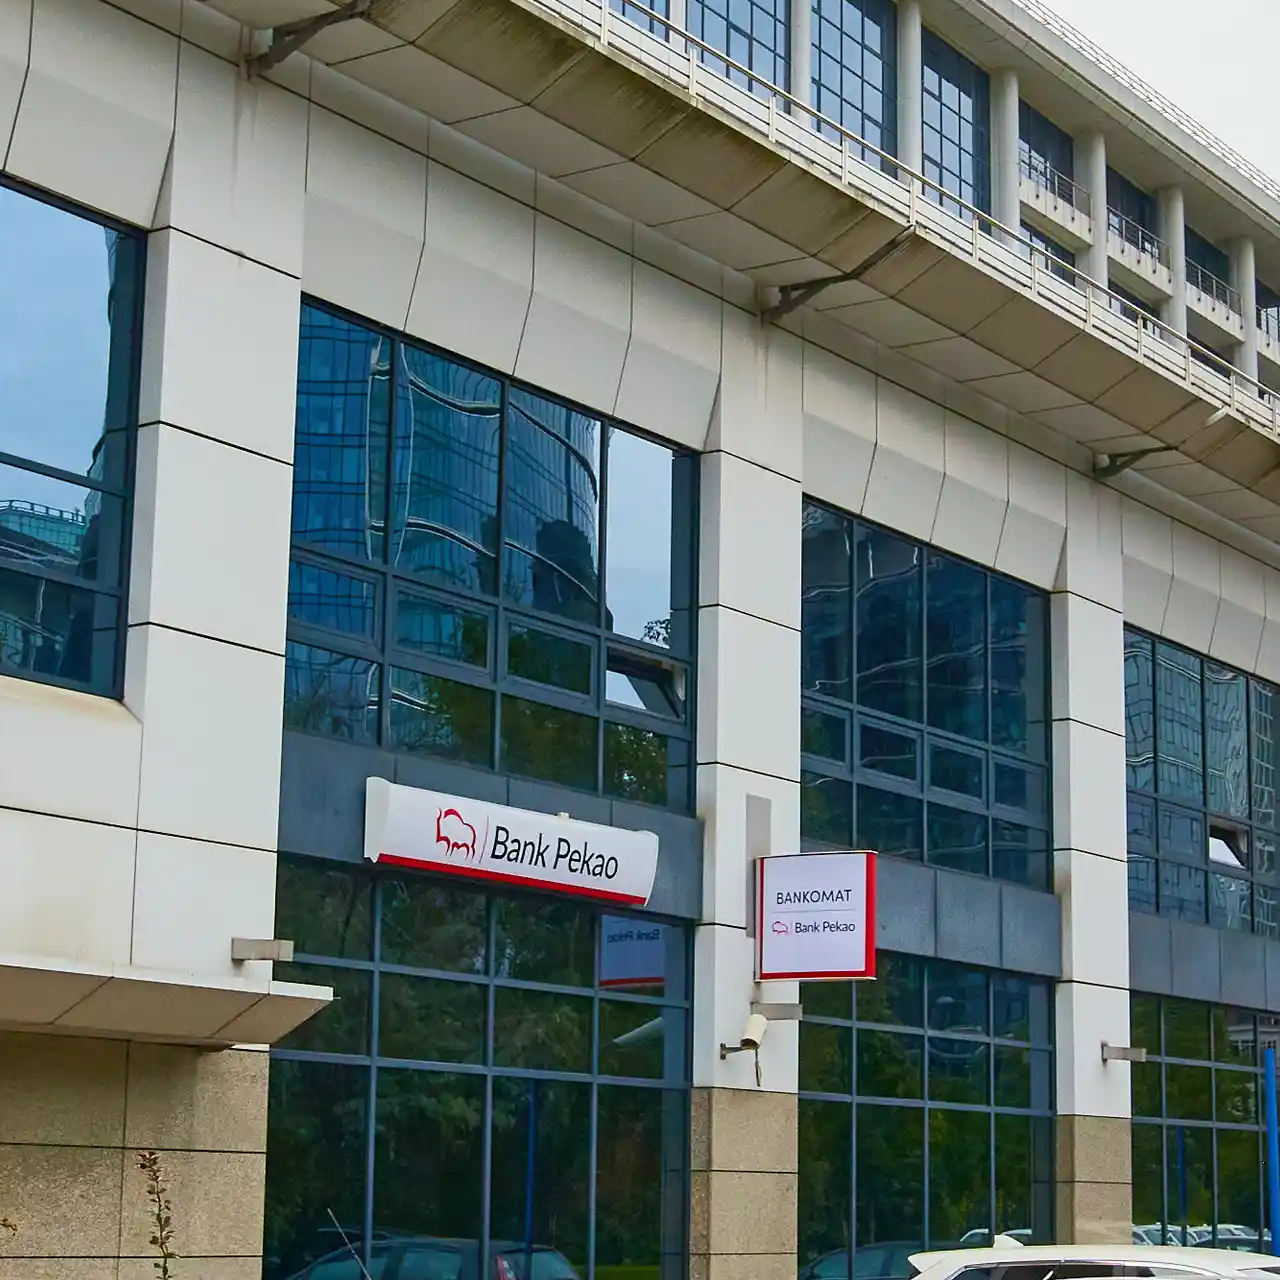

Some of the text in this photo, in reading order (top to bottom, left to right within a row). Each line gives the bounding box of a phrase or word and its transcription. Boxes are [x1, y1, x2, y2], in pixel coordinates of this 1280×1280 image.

[490, 825, 619, 880] Bank Pekao
[776, 889, 852, 905] BANKOMAT
[794, 920, 856, 934] Bank Pekao
